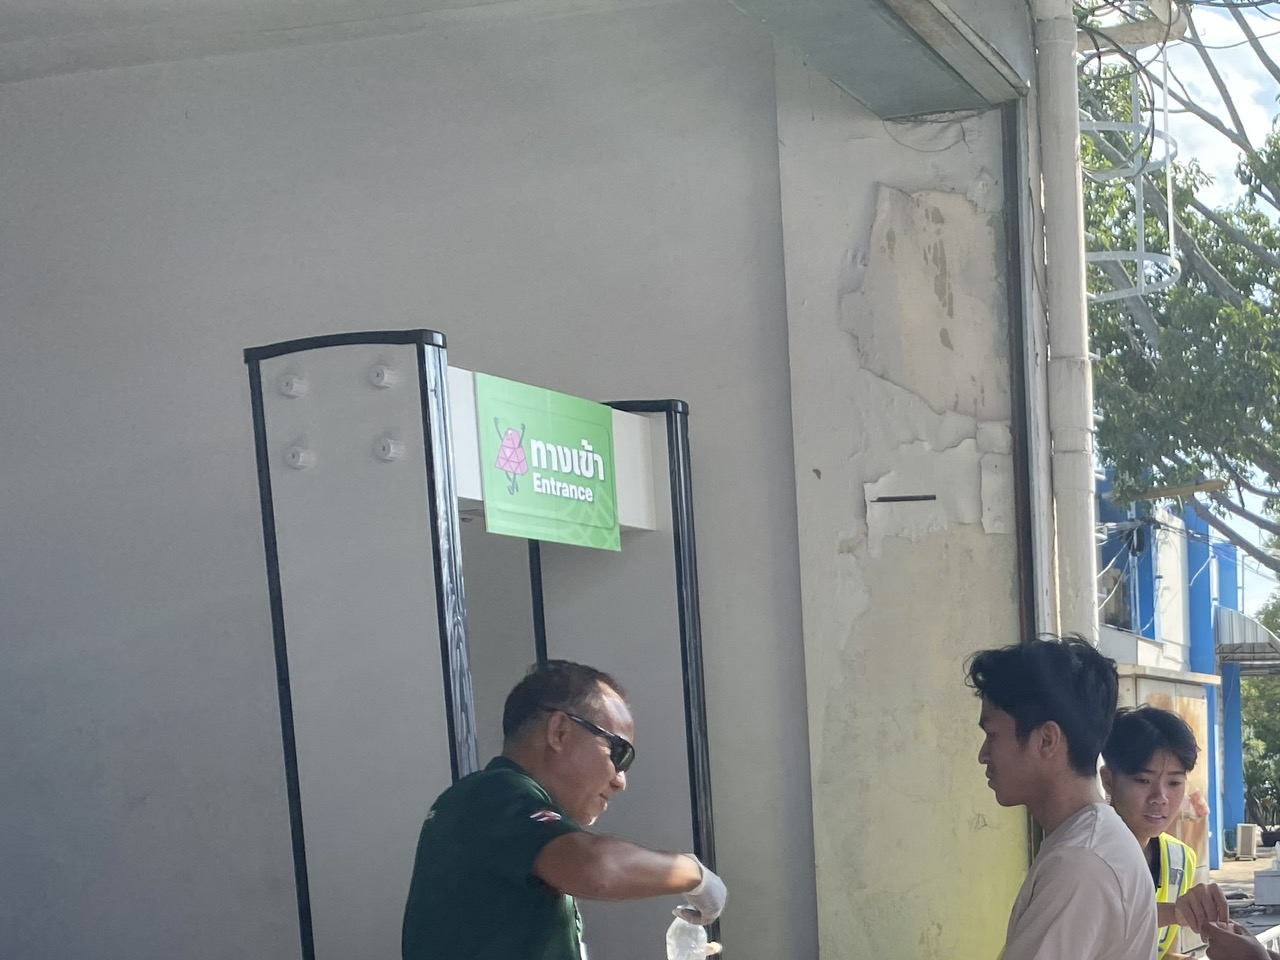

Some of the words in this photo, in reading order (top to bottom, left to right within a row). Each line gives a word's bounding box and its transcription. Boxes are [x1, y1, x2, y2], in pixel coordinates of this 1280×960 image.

[530, 438, 605, 480] ทางเข้า
[532, 472, 593, 502] Entrance
